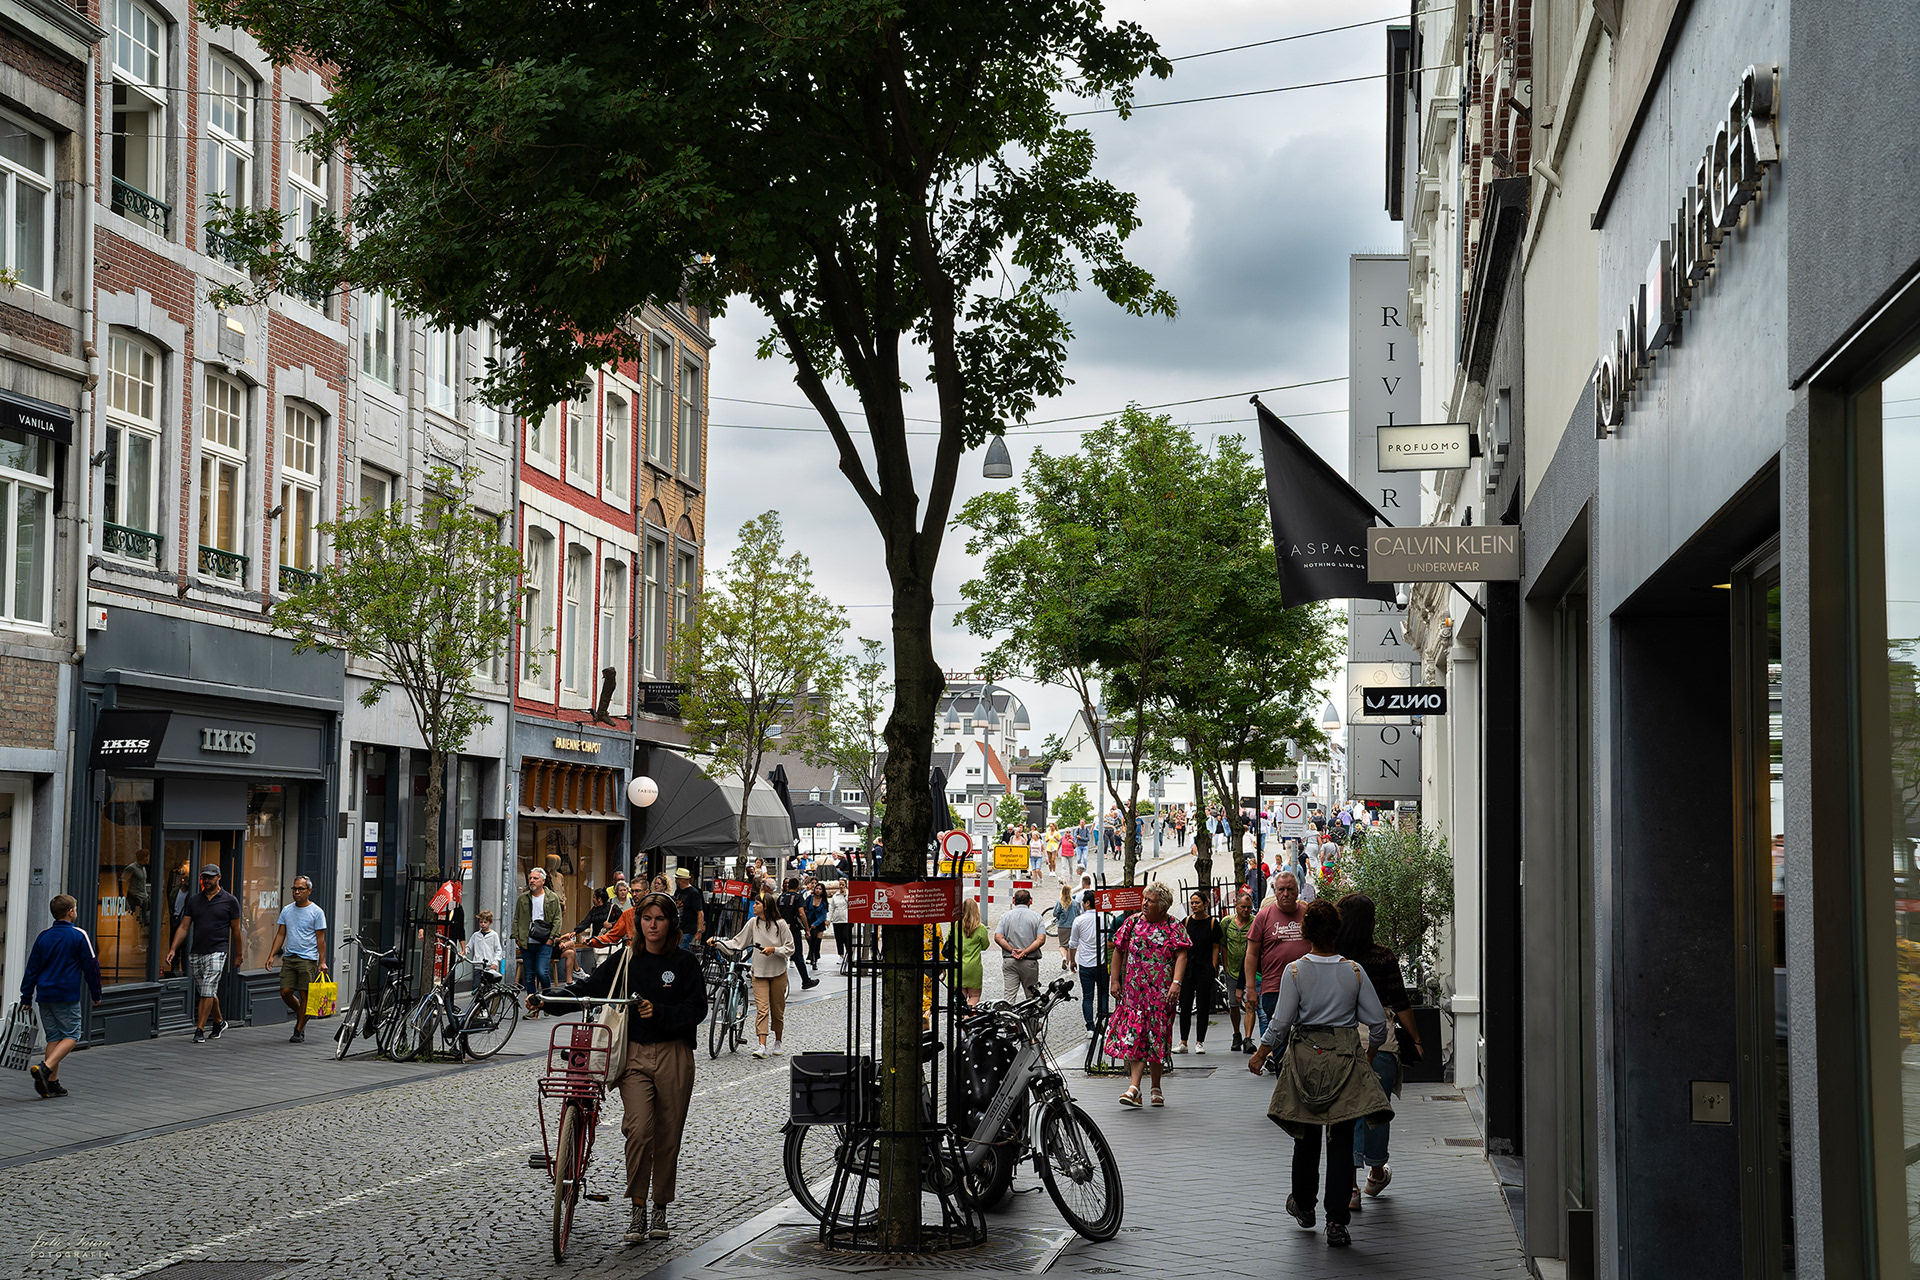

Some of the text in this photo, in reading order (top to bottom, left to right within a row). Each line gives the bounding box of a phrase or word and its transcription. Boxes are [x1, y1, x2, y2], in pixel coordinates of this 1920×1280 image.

[1381, 307, 1402, 508] RIVIR
[18, 413, 55, 433] VANILIA
[1388, 442, 1459, 452] PROFUOMO
[1290, 542, 1368, 557] ASPAC
[1374, 535, 1513, 556] CALVIN KLEIN
[1408, 562, 1480, 573] UNDERWEAR
[1388, 694, 1441, 709] ZUMO
[101, 739, 150, 749] IKKS
[202, 728, 256, 754] IKKS
[581, 740, 601, 754] CHAPOT
[101, 896, 117, 916] NEW
[997, 1096, 1013, 1122] STELLA
